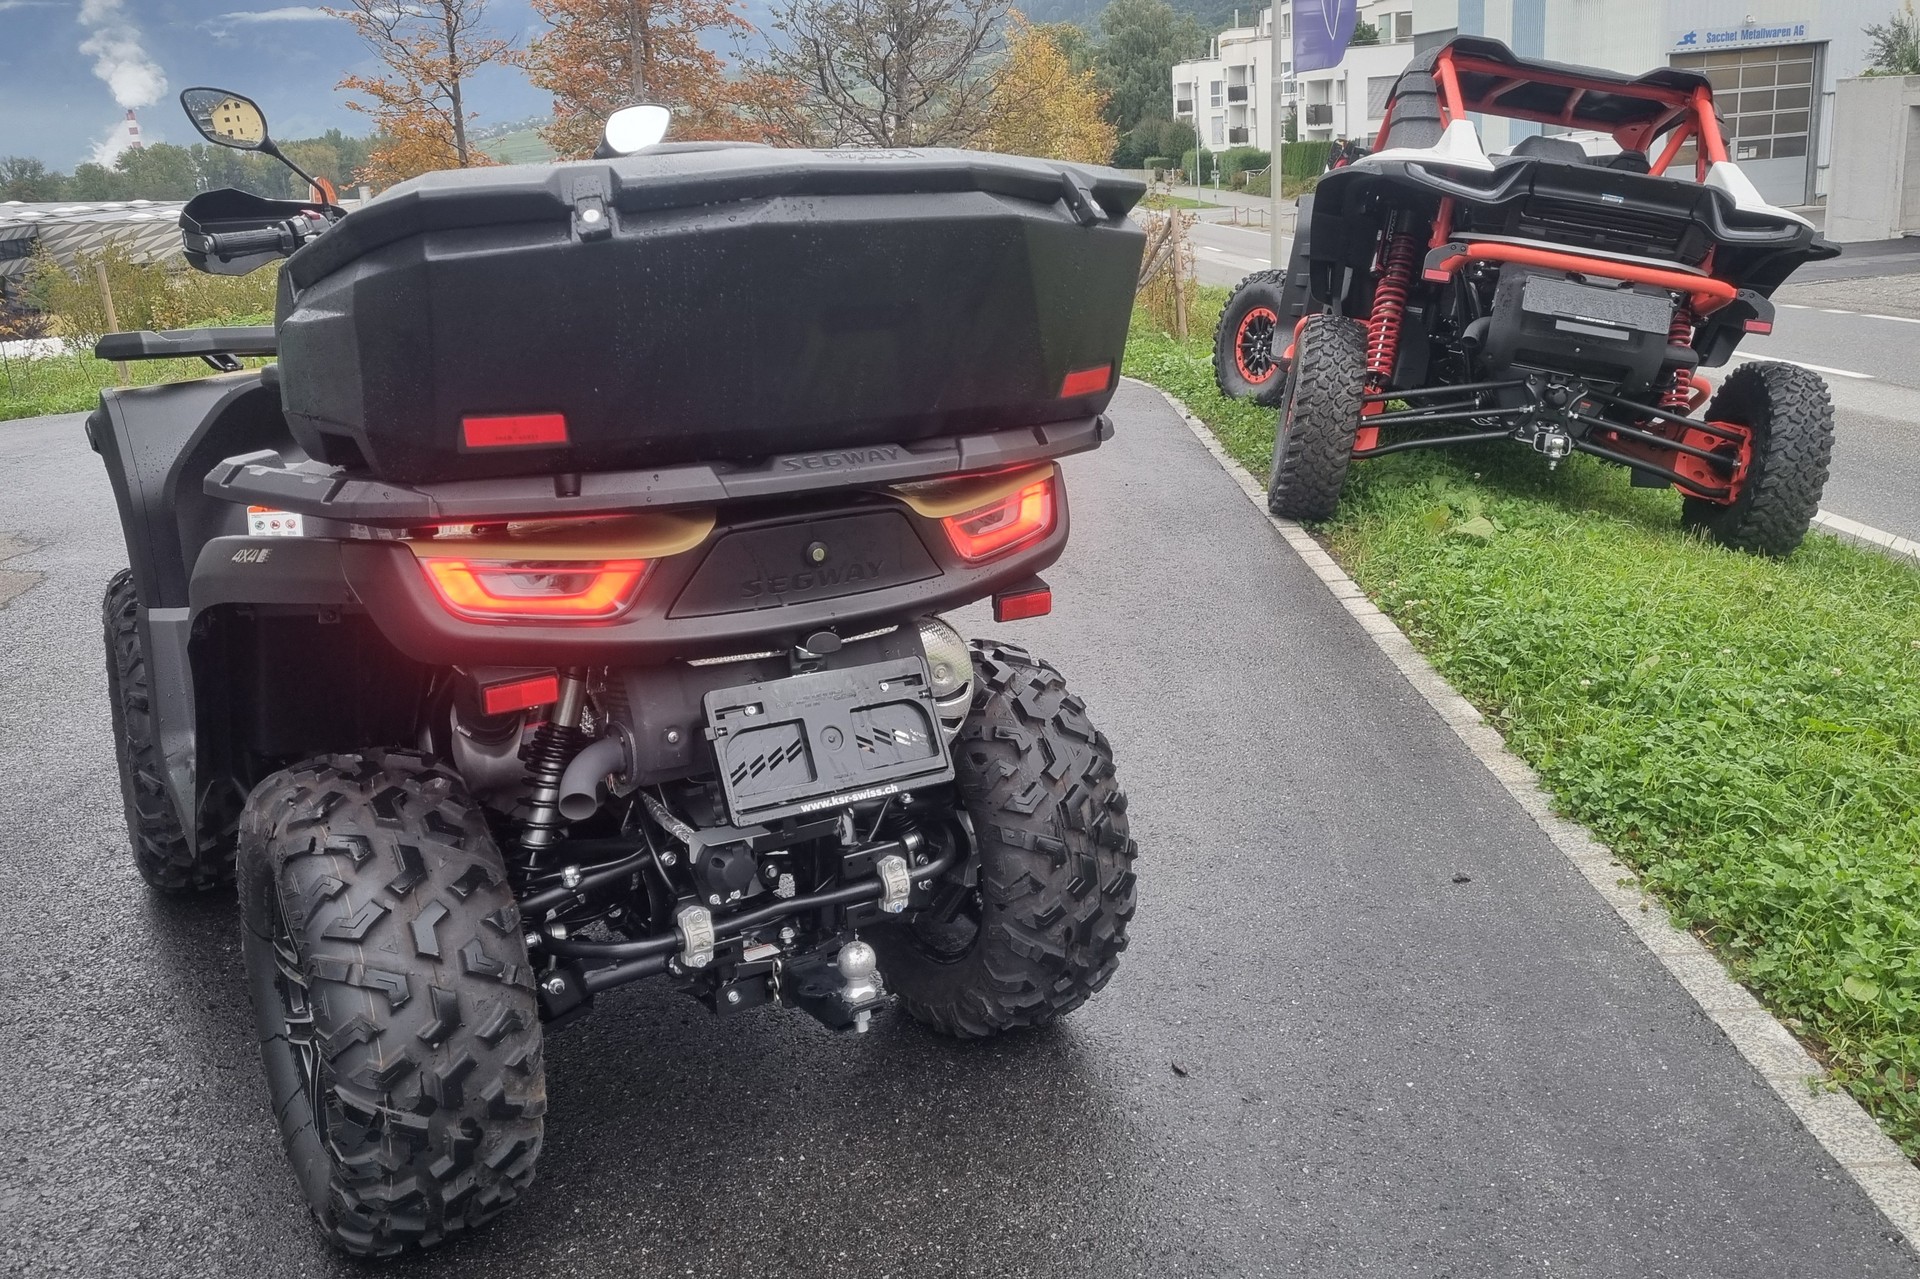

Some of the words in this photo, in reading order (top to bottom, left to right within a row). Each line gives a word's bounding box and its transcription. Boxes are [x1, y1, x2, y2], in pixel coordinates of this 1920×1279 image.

[1706, 31, 1737, 43] Sacchet
[1740, 27, 1791, 41] Metallwaren
[1793, 25, 1804, 36] AG
[781, 446, 898, 472] SEGWAY
[741, 560, 884, 599] SEGWAY
[800, 784, 899, 813] www.ksr-swiss.ch
